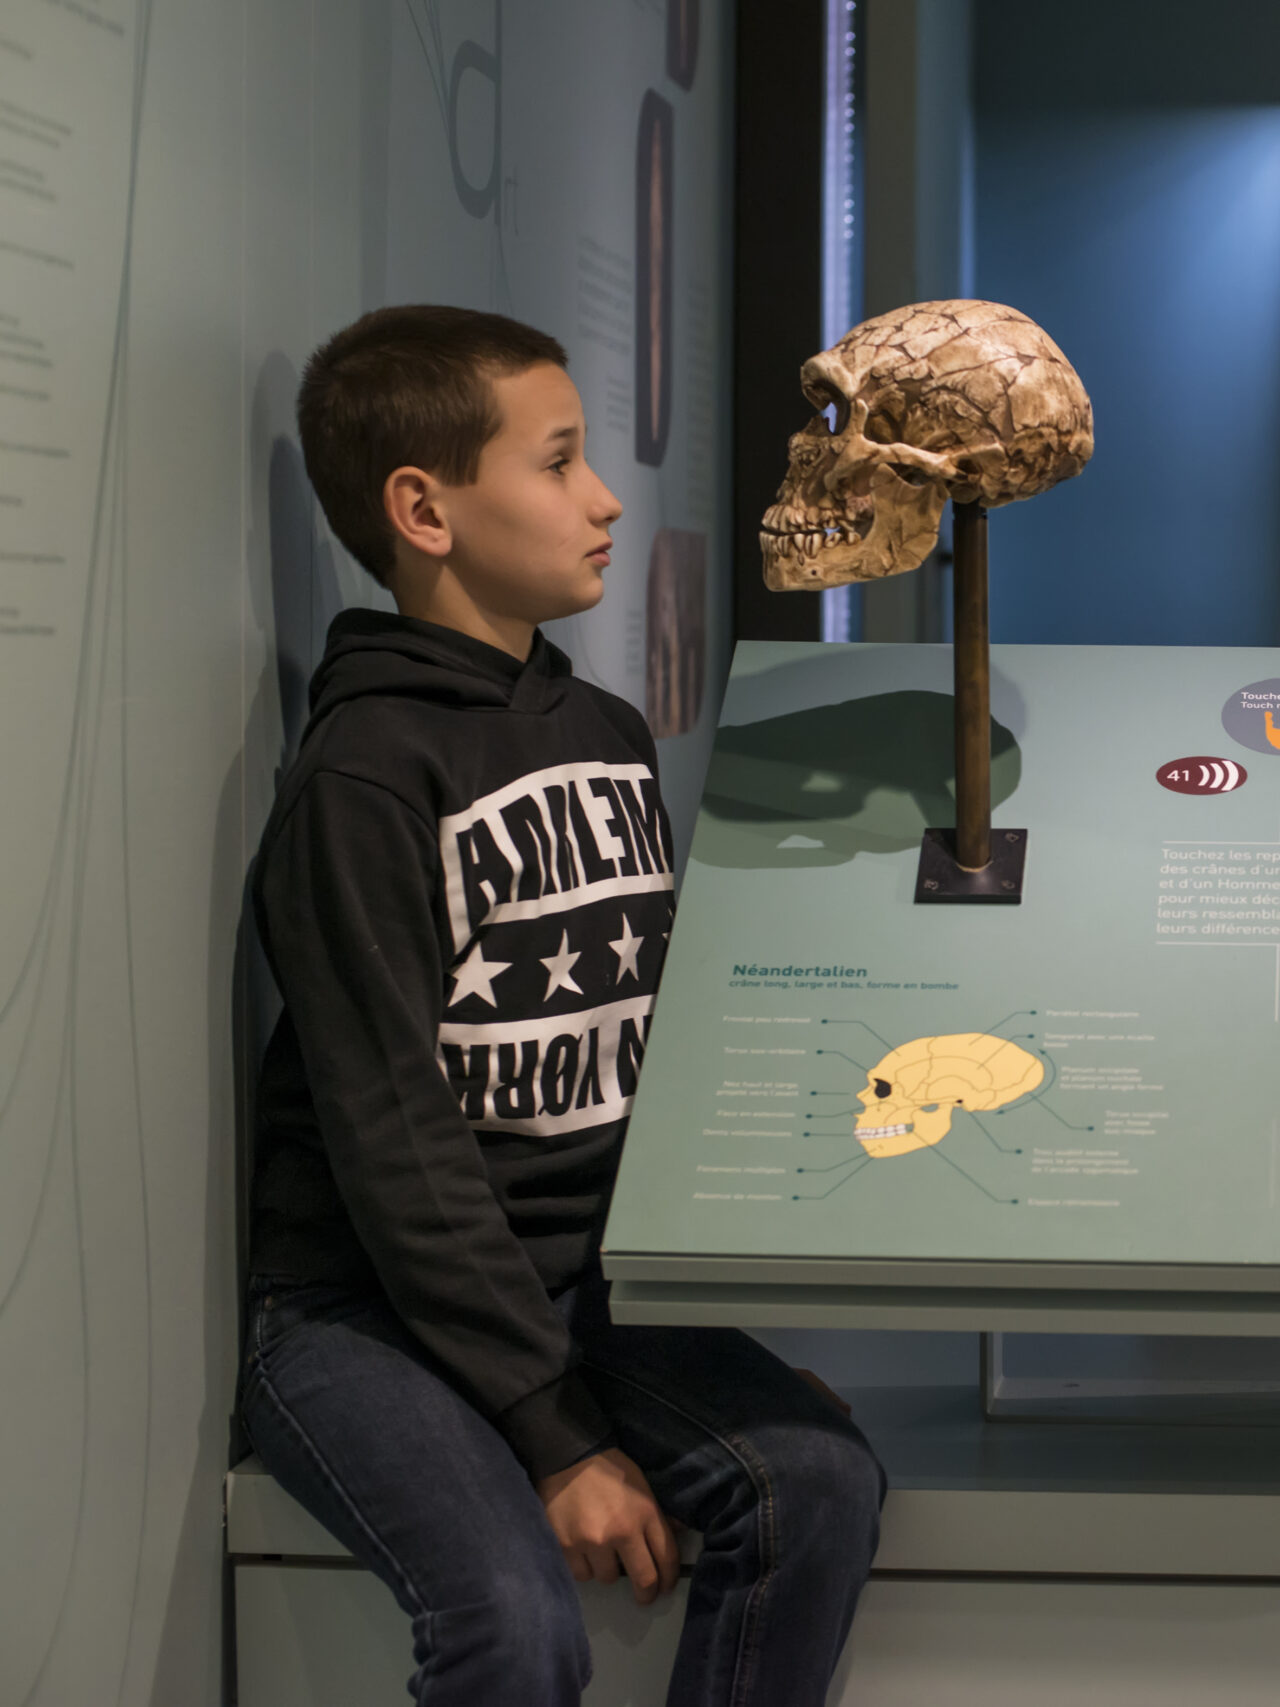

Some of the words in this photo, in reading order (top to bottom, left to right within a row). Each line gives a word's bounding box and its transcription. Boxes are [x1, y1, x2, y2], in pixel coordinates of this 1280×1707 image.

[1240, 701, 1274, 709] Touch
[1166, 770, 1190, 782] 41
[1162, 848, 1225, 861] Touchez
[1229, 850, 1251, 861] les
[1160, 864, 1188, 875] des
[1192, 864, 1246, 876] crânes
[1159, 879, 1174, 889] et
[1179, 879, 1213, 889] d'un
[1218, 879, 1280, 890] Homme
[1158, 895, 1195, 906] pour
[1199, 894, 1248, 905] mieux
[1157, 908, 1198, 919] leurs
[1156, 923, 1197, 934] leurs
[732, 964, 868, 978] Néandertalien
